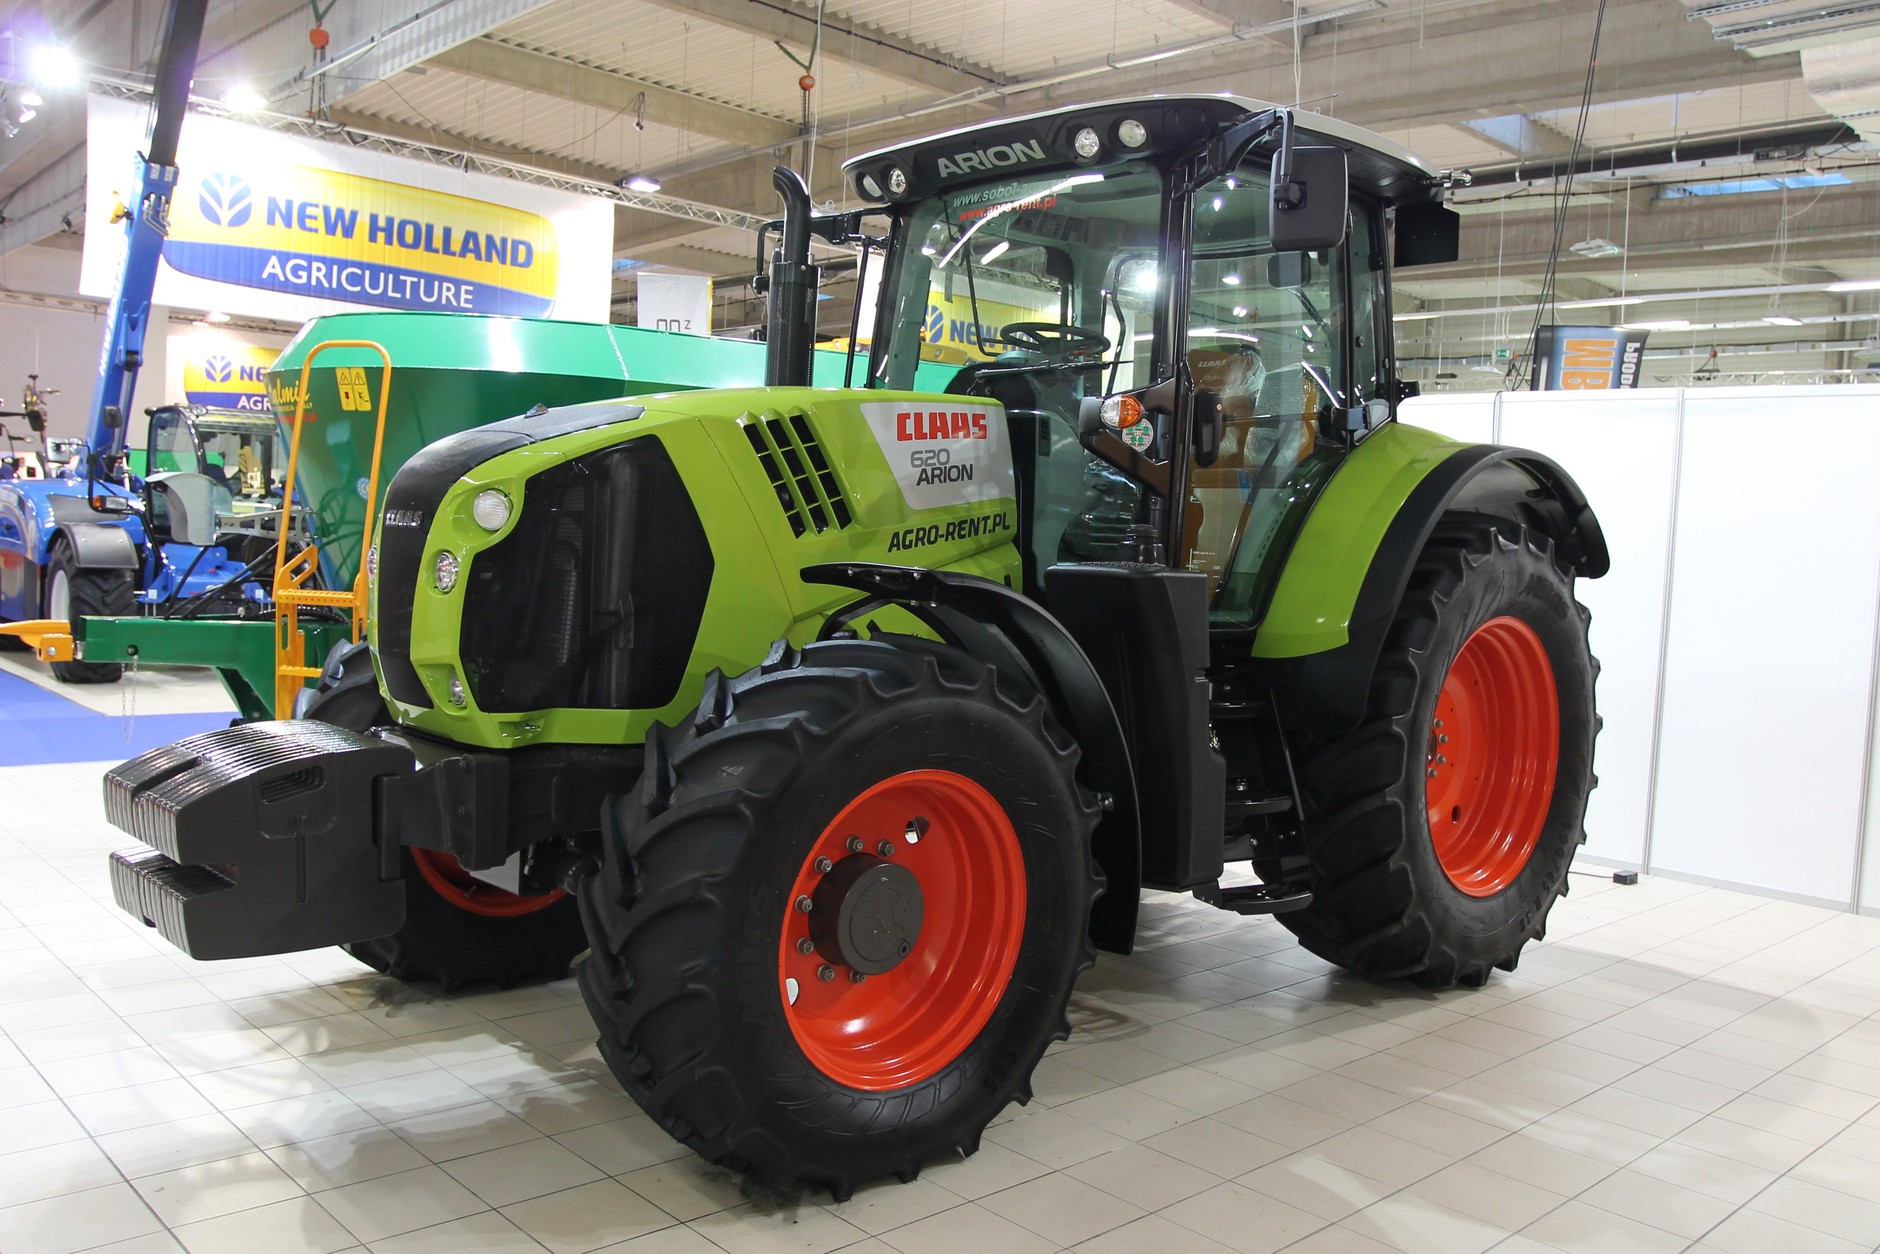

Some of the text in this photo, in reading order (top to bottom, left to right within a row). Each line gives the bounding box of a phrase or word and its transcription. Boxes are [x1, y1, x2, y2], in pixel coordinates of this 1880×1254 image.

[937, 139, 1046, 178] ARION
[266, 196, 534, 269] NEW HOLLAND
[262, 255, 474, 309] AGRICULTURE
[951, 319, 998, 347] NEW
[897, 412, 988, 441] CLAAS
[910, 448, 950, 468] 620
[916, 464, 974, 486] ARION
[887, 512, 1011, 553] AGRO-RENT.PL
